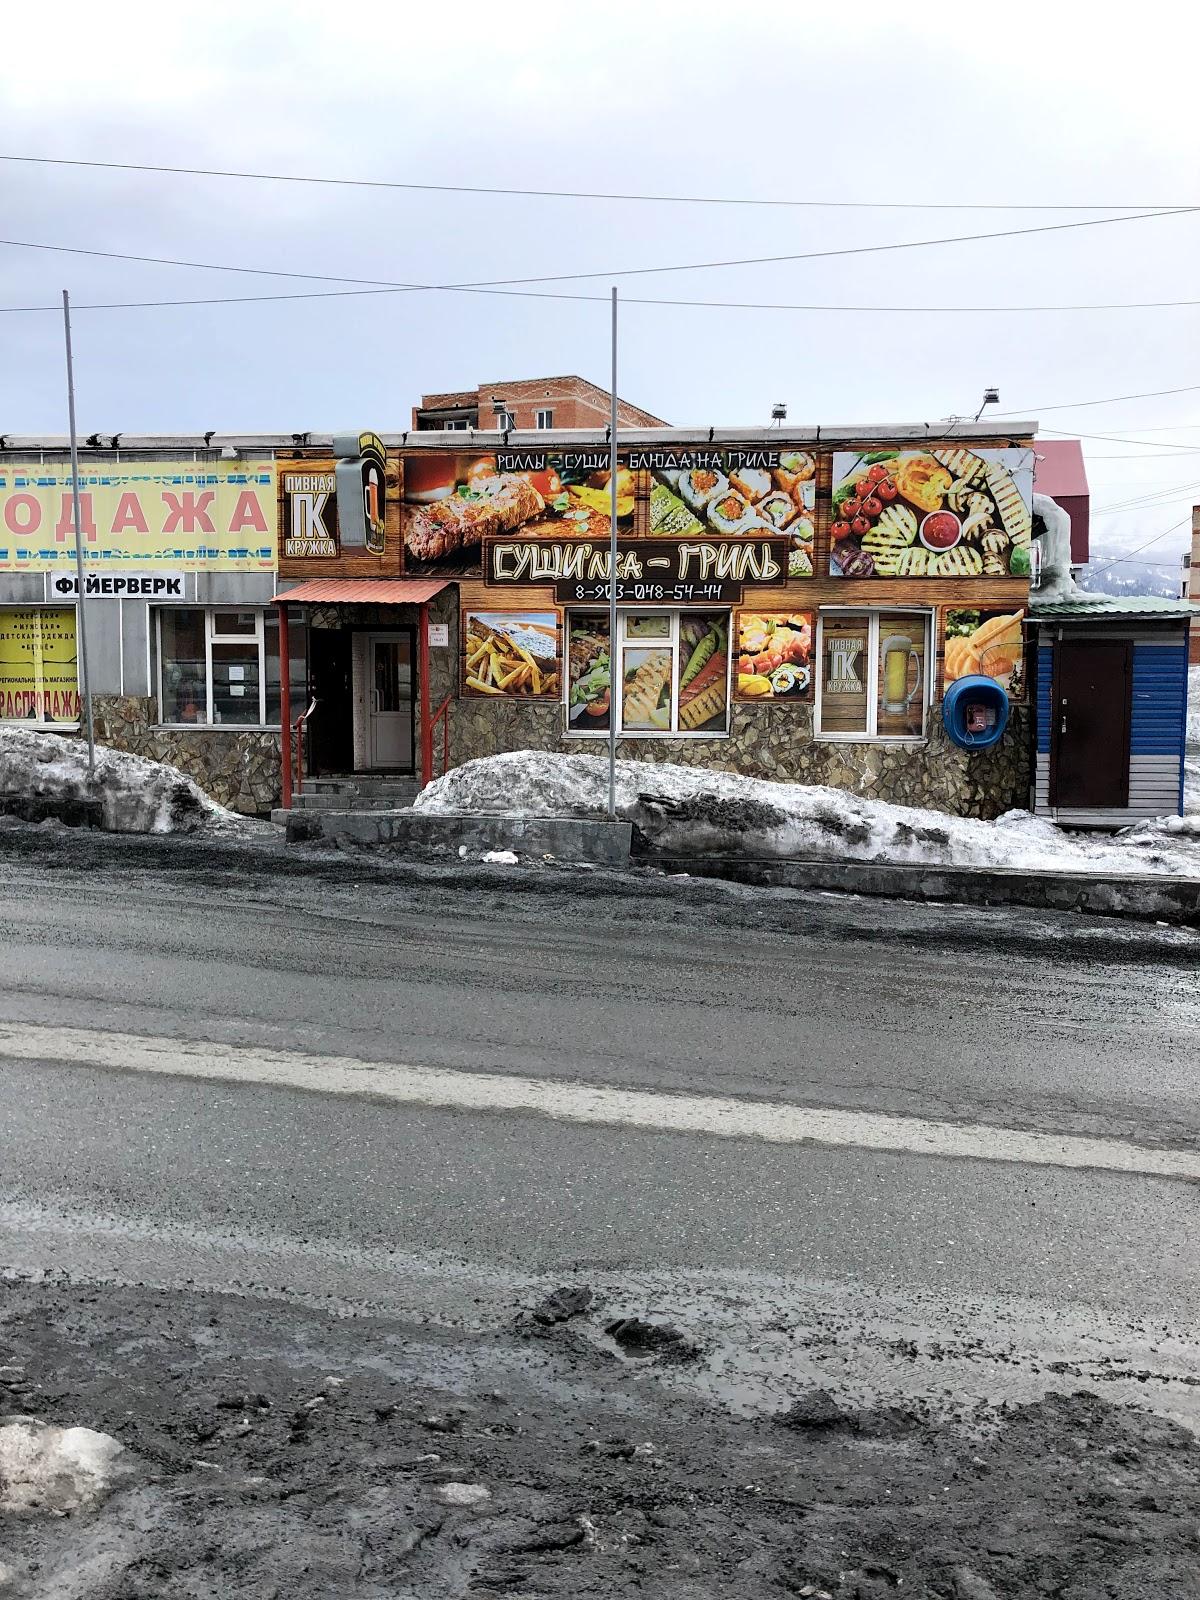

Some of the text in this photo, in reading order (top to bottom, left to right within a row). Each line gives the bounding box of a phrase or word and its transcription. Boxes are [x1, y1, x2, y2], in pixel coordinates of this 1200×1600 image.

[497, 454, 545, 469] РОЛЛЫ
[565, 454, 609, 469] СУШИ
[629, 453, 691, 469] БЛЮДА
[697, 453, 722, 468] НА
[728, 452, 778, 468] ГРИЛЕ
[286, 475, 336, 492] ПИВНАЯ
[4, 490, 269, 542] ОДАЖА
[293, 493, 328, 538] ПК
[287, 540, 336, 555] КРУЖКА
[678, 543, 781, 580] ГРИЛЬ
[575, 584, 722, 600] 8-903-048-54-44
[829, 639, 863, 650] ПИВНАЯ
[832, 651, 857, 680] ПК
[828, 681, 861, 691] КРУЖКА
